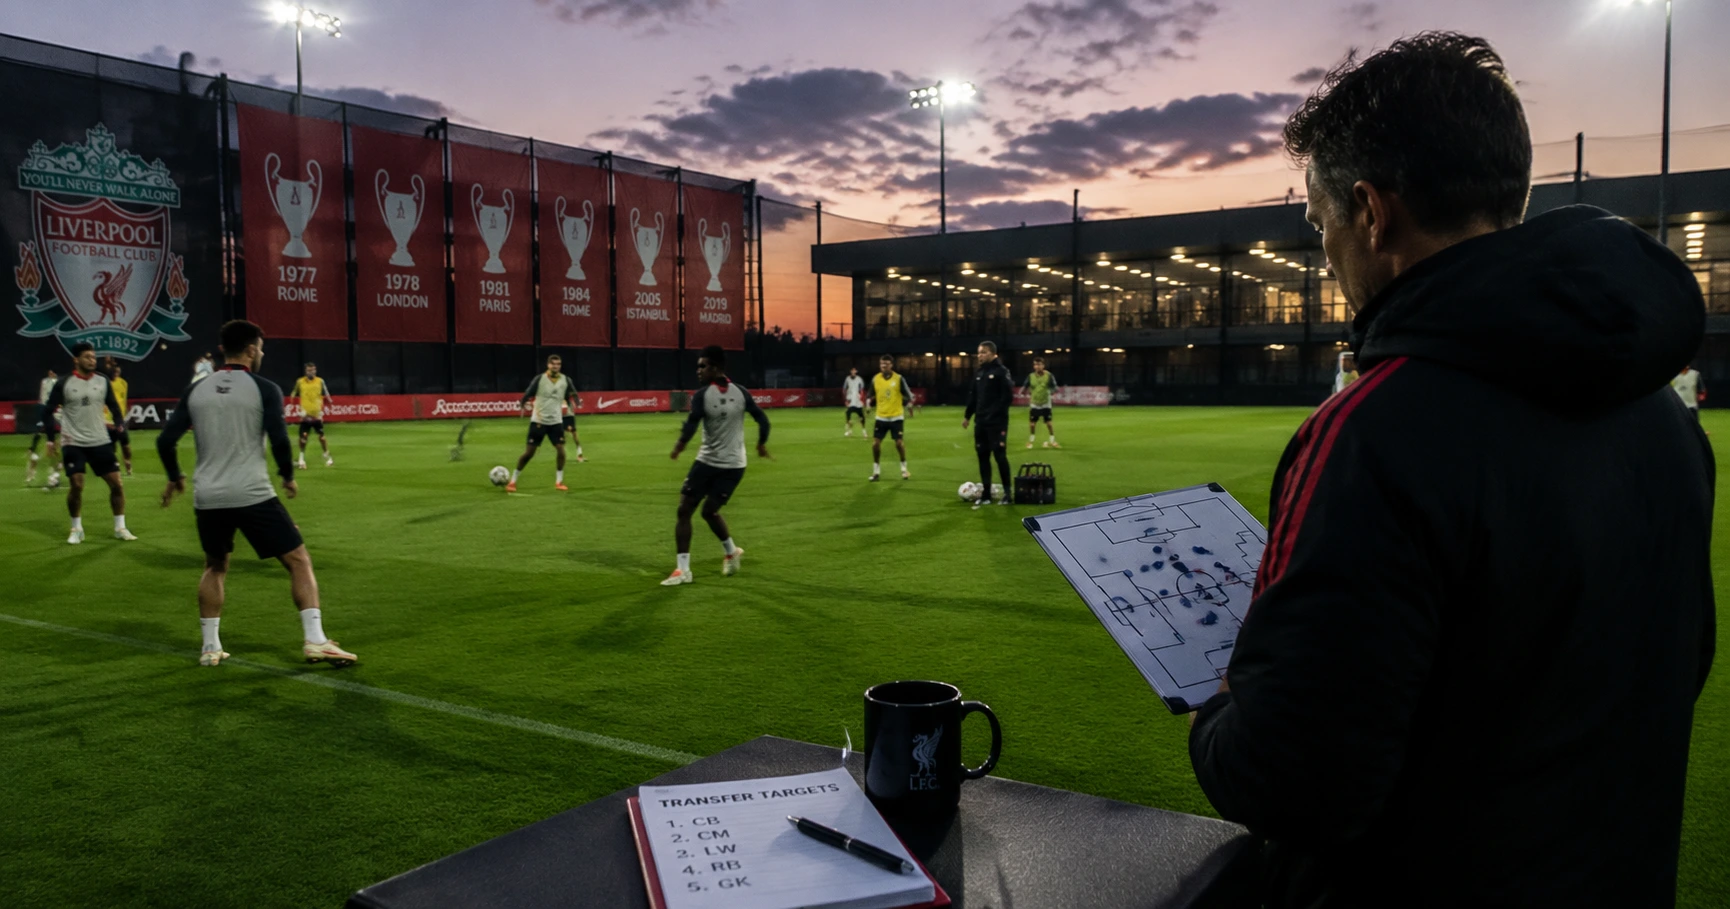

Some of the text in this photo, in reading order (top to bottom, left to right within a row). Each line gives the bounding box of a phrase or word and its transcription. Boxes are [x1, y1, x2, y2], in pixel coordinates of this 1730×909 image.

[66, 178, 104, 194] NEVER
[105, 184, 138, 198] WALK
[140, 188, 177, 203] ALONE
[46, 215, 161, 245] LIVERPOOL
[52, 242, 157, 262] FOOTBALL CLUB
[278, 265, 317, 285] 1977
[384, 274, 420, 291] 1978
[277, 285, 318, 303] ROME
[479, 280, 510, 297] 1981
[562, 286, 591, 302] 1984
[377, 293, 428, 309] LONDON
[479, 298, 511, 313] PARIS
[634, 291, 661, 306] 2005
[703, 296, 728, 311] 2019
[562, 303, 591, 317] ROME
[626, 307, 670, 322] ISTANBUL
[699, 311, 732, 325] MADRID
[658, 783, 840, 808] TRANSFER TARGETS
[666, 816, 721, 828] 1. CB
[671, 829, 730, 843] 2. CM
[704, 844, 736, 856] LW
[682, 860, 742, 875] 4. RB
[687, 876, 752, 892] 5. GK
